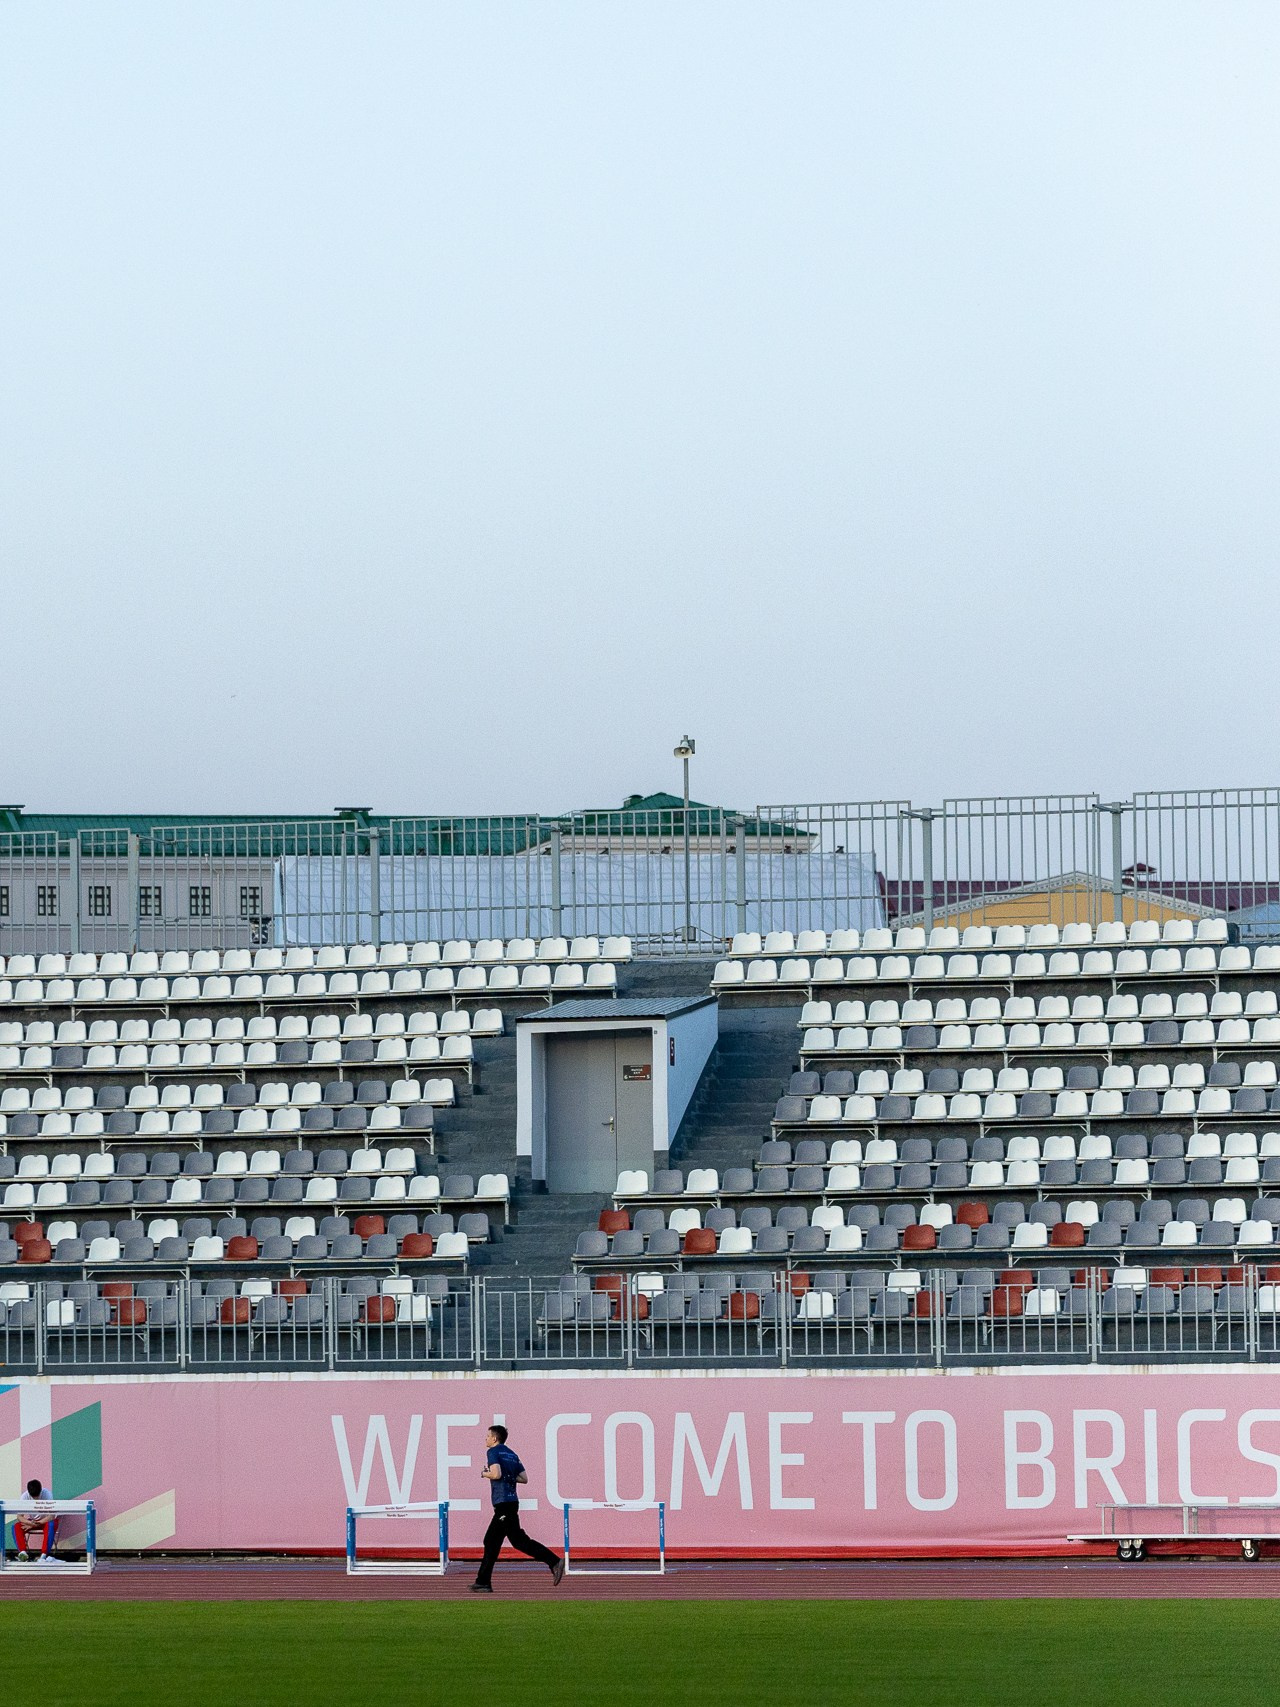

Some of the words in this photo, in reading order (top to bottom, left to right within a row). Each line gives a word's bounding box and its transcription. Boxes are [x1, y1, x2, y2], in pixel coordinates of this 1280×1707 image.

[332, 1412, 816, 1513] WECOME
[842, 1410, 959, 1511] TO
[1003, 1408, 1280, 1509] BRICS
